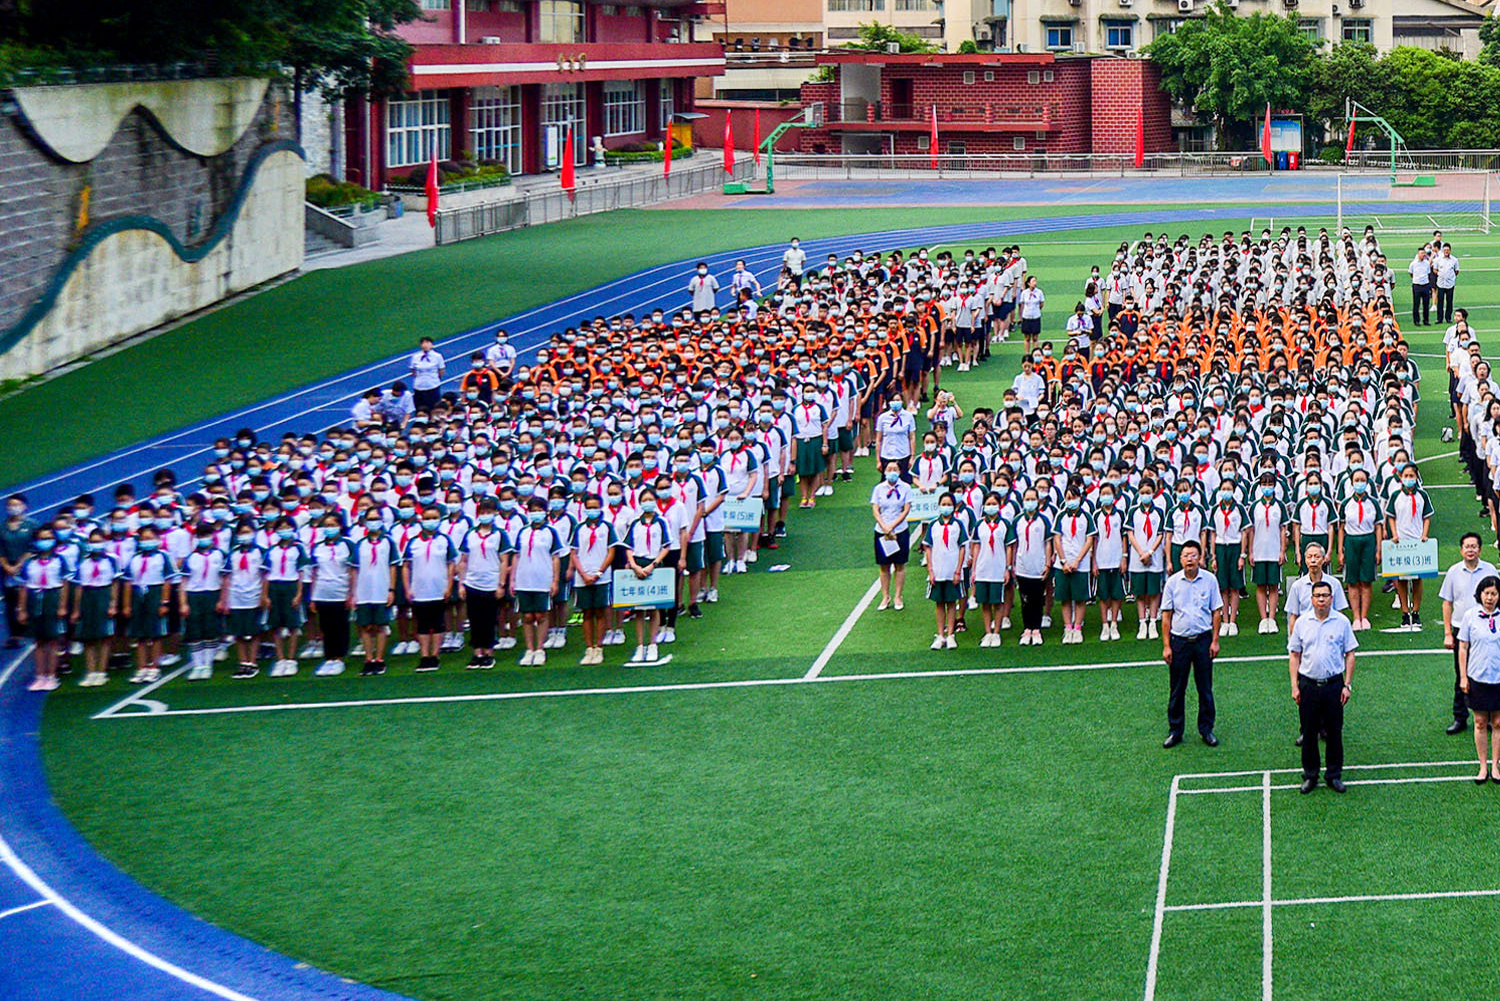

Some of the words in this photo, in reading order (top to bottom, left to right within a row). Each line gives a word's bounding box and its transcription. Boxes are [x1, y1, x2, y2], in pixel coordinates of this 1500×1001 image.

[1389, 555, 1432, 566] 七年级(3)班
[621, 584, 668, 597] 七年级(4)班
